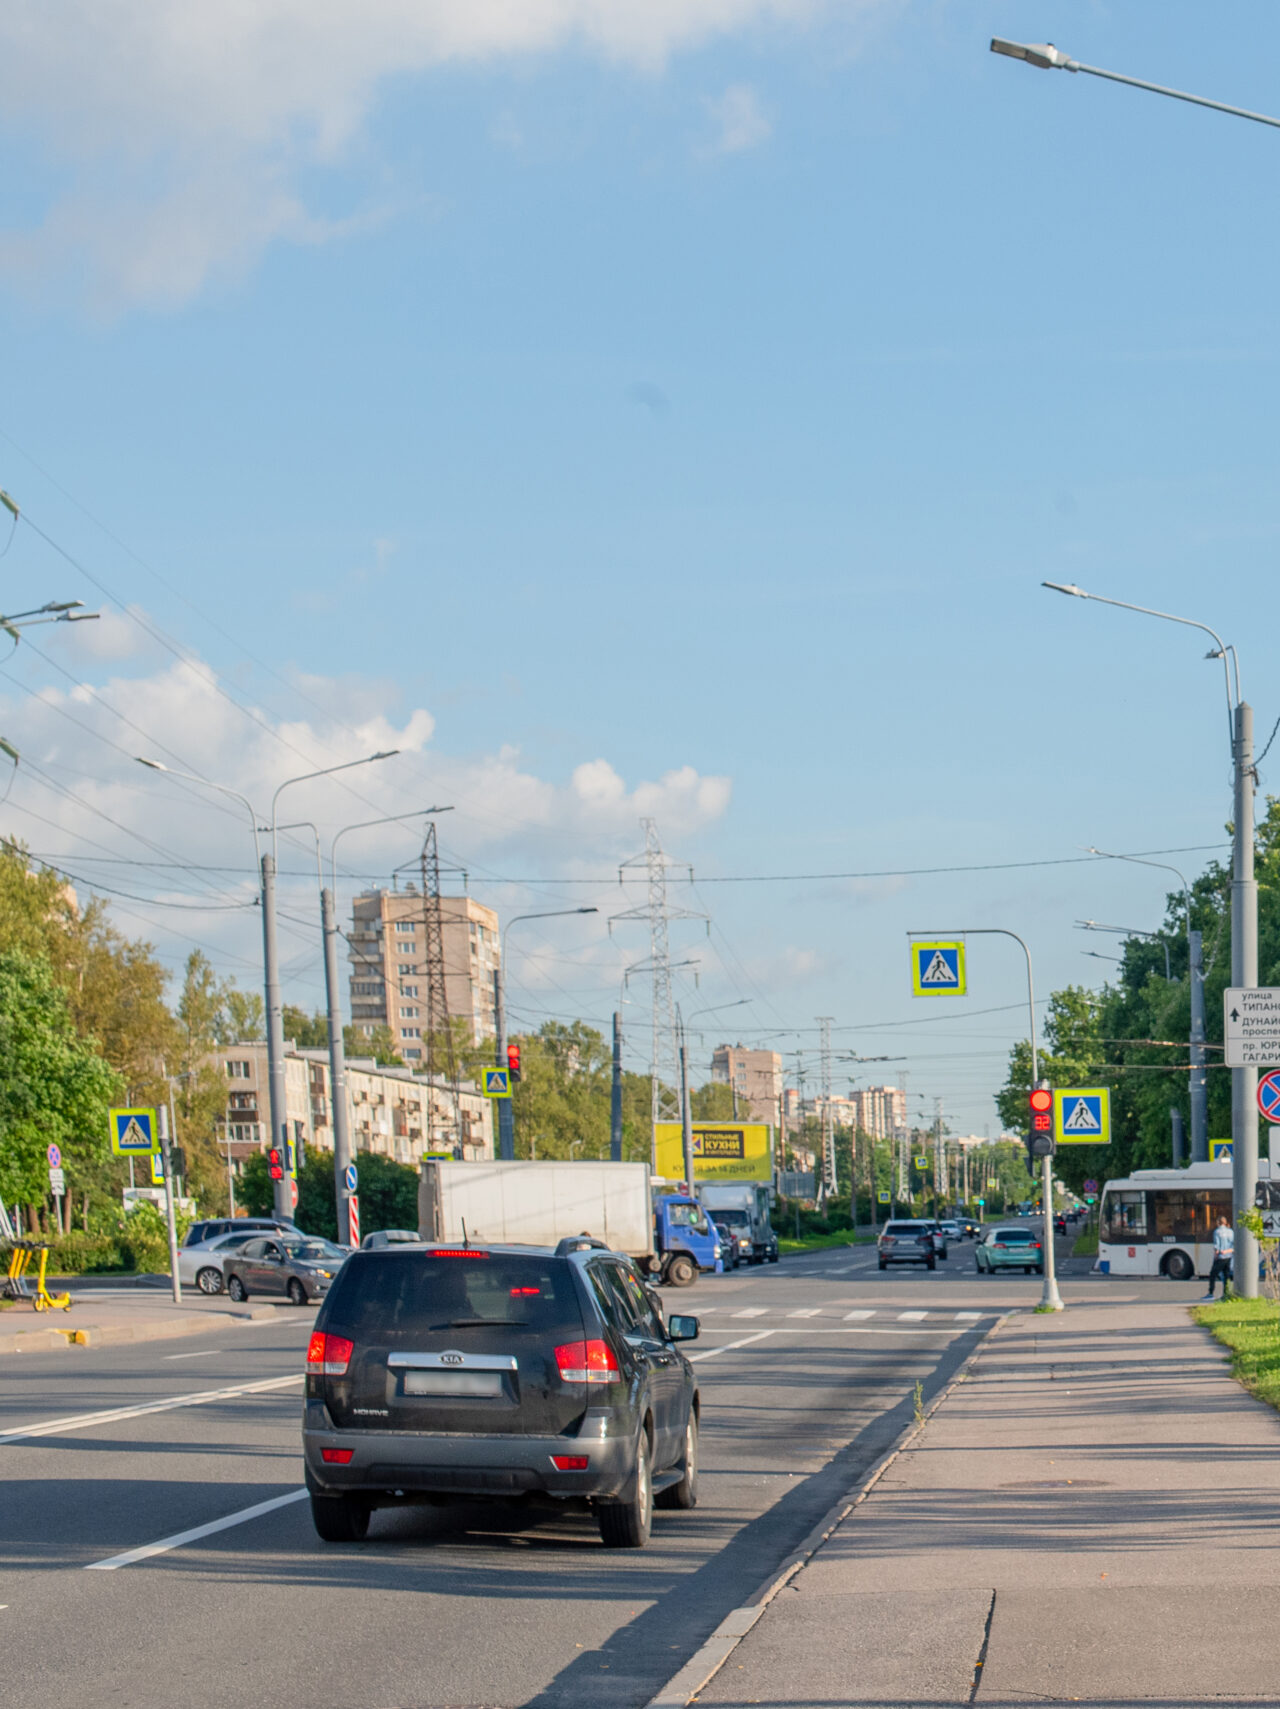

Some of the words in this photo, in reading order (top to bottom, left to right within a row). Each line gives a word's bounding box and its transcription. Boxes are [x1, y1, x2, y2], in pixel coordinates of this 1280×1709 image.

[1242, 993, 1272, 1001] улица
[1242, 1043, 1258, 1051] пр.
[1034, 1115, 1051, 1131] 32
[705, 1141, 740, 1150] КУХНИ
[443, 1355, 462, 1364] KIA
[353, 1408, 389, 1417] MOHAVE
